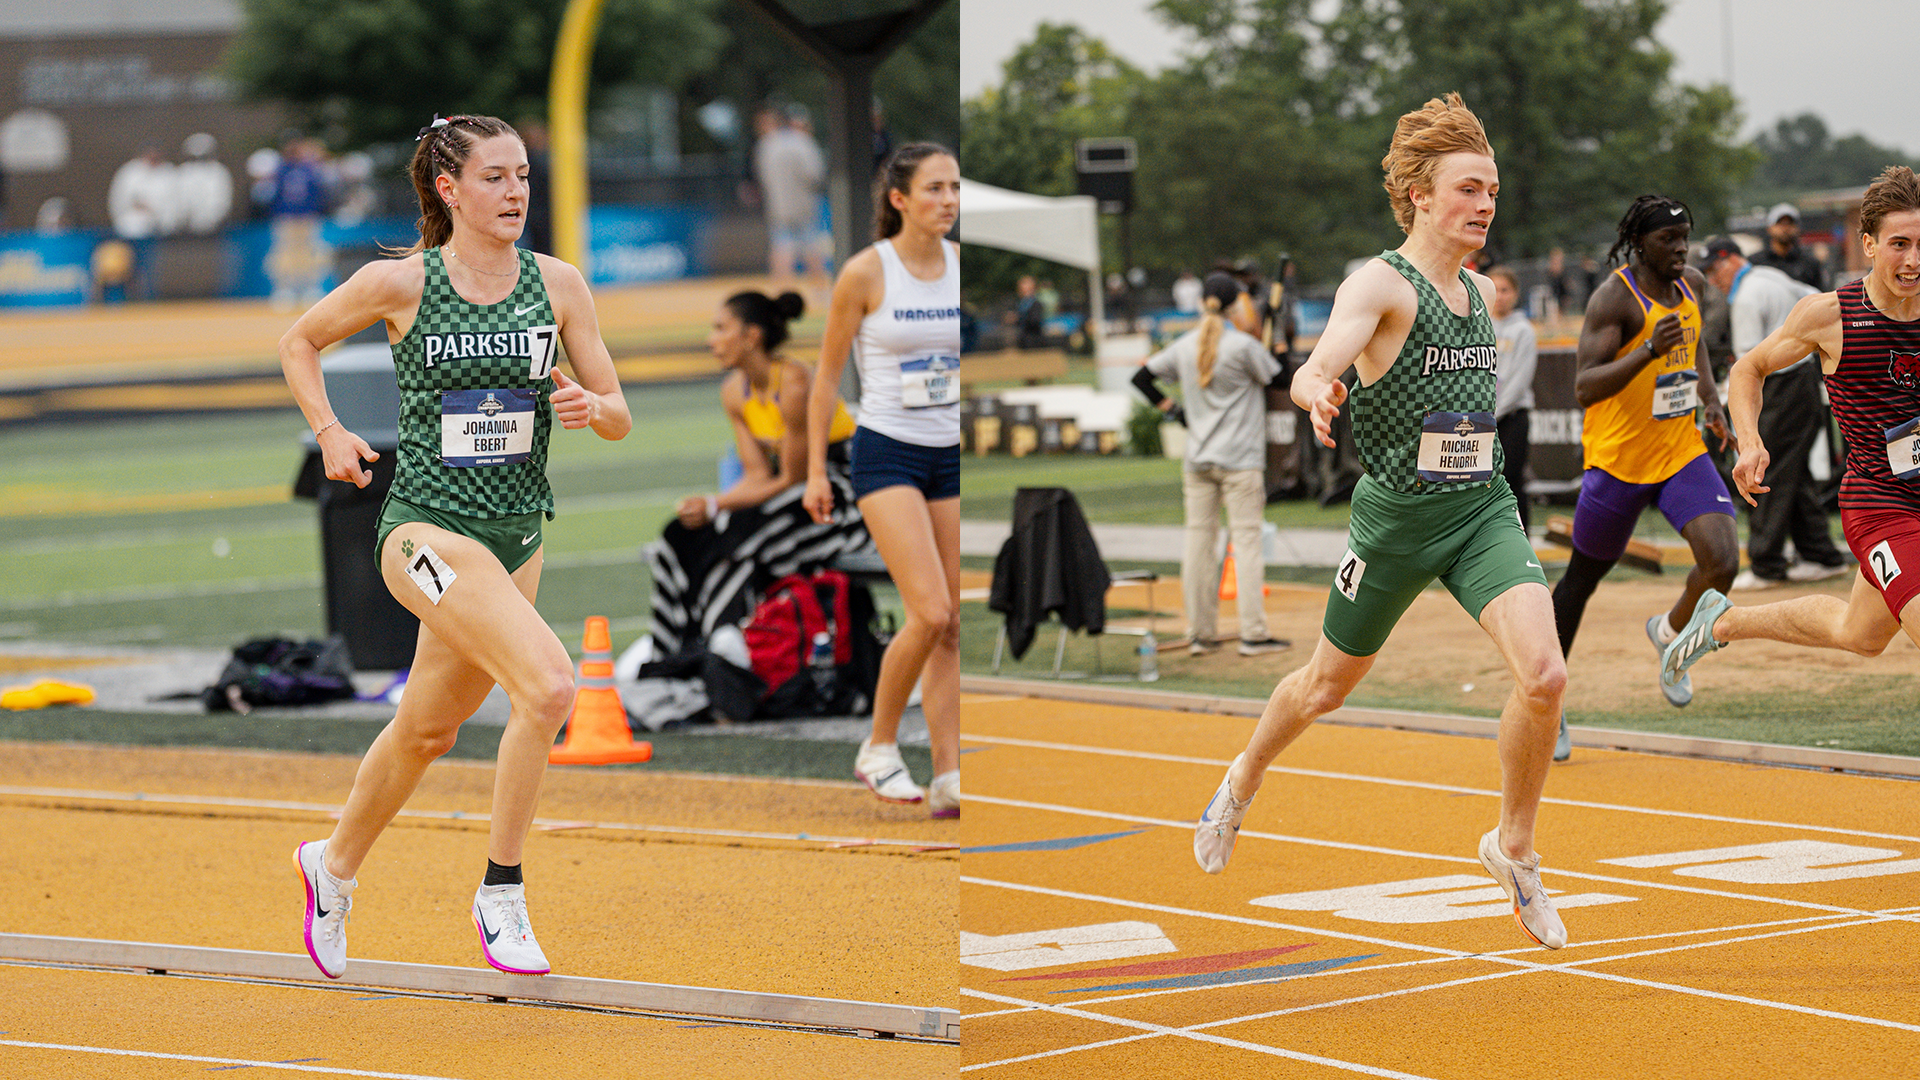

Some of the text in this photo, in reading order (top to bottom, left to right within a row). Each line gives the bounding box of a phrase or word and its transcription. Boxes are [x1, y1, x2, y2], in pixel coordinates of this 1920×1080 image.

[1852, 320, 1875, 328] CENTRAL
[425, 332, 532, 368] PARKSID
[536, 331, 553, 377] 7
[1422, 346, 1497, 376] PARKSIDE
[1665, 347, 1690, 368] STATE
[463, 420, 517, 435] JOHANNA
[474, 437, 508, 452] EBERT
[1441, 440, 1479, 453] MICHAEL
[1439, 455, 1478, 468] HENDRIX
[413, 553, 444, 594] 7
[1339, 557, 1357, 593] 4
[1872, 550, 1895, 585] 2
